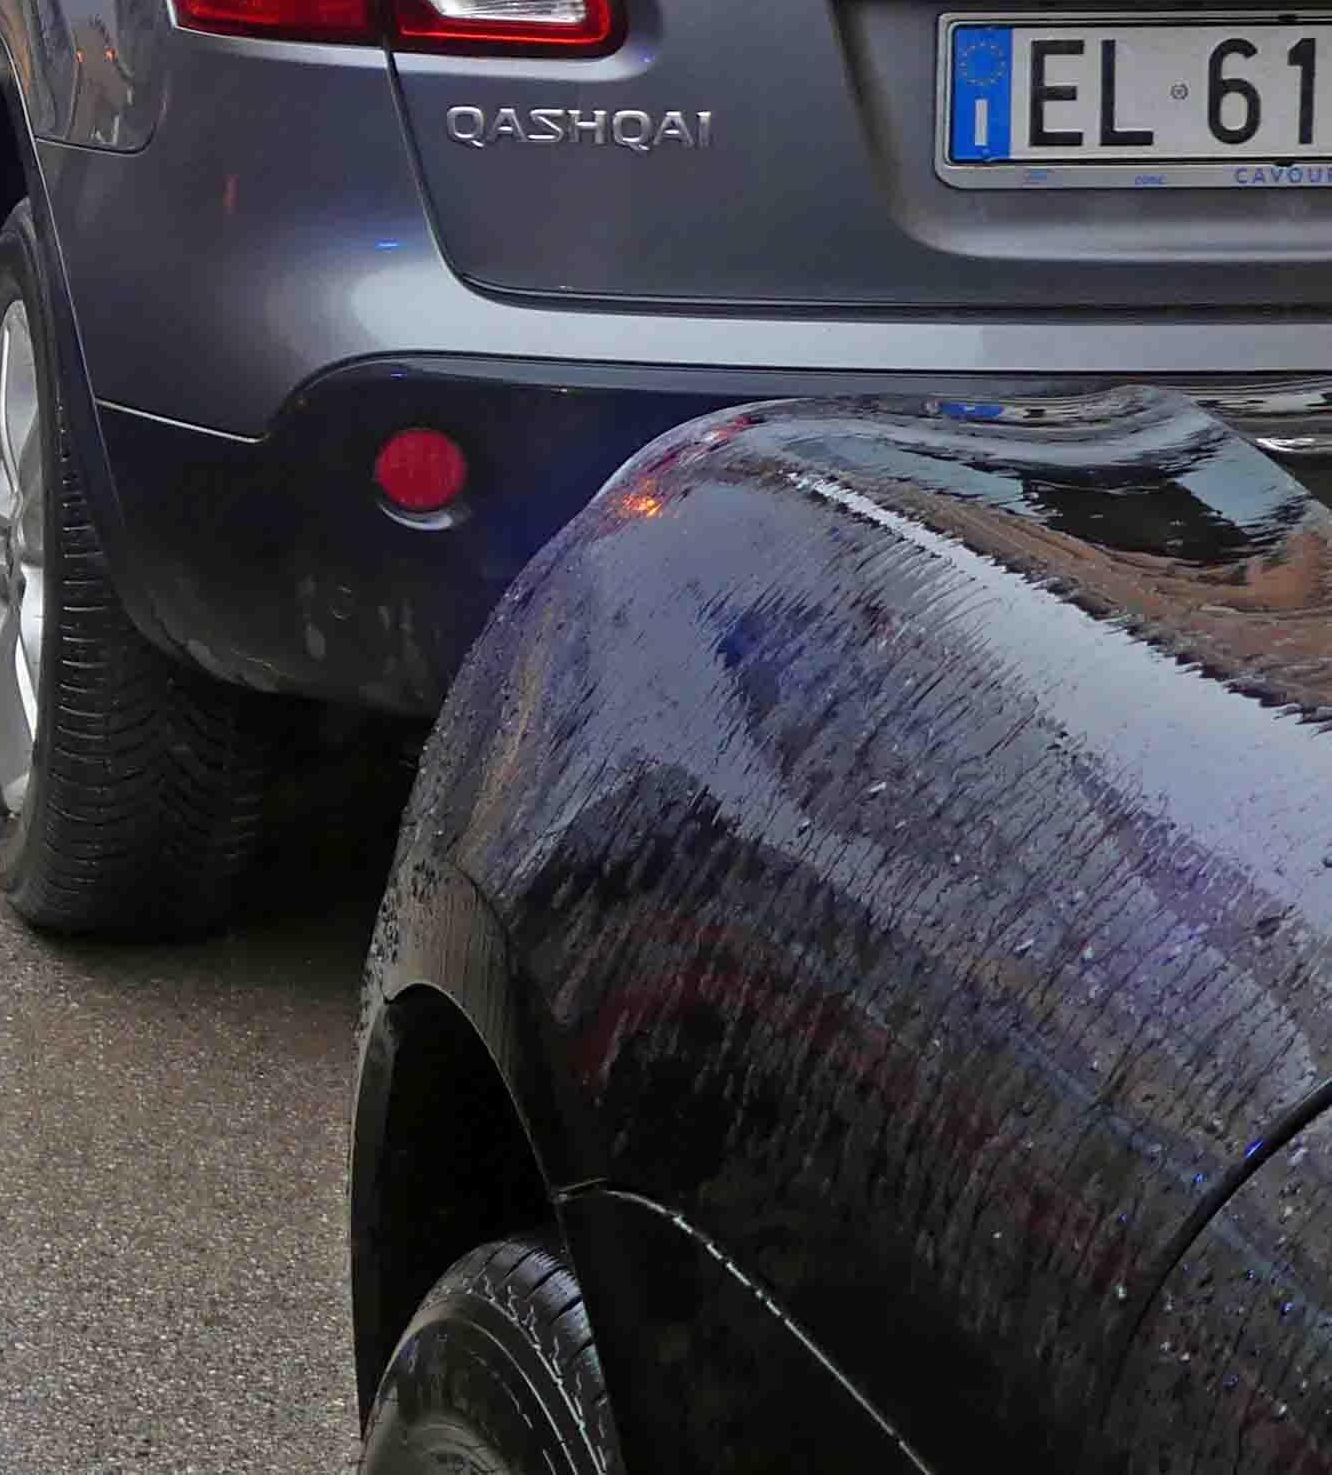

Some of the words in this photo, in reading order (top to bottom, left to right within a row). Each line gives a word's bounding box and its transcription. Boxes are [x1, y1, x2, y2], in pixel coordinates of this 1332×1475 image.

[446, 106, 712, 151] QASHQAI
[1029, 39, 1154, 147] EL
[1207, 37, 1317, 145] 61
